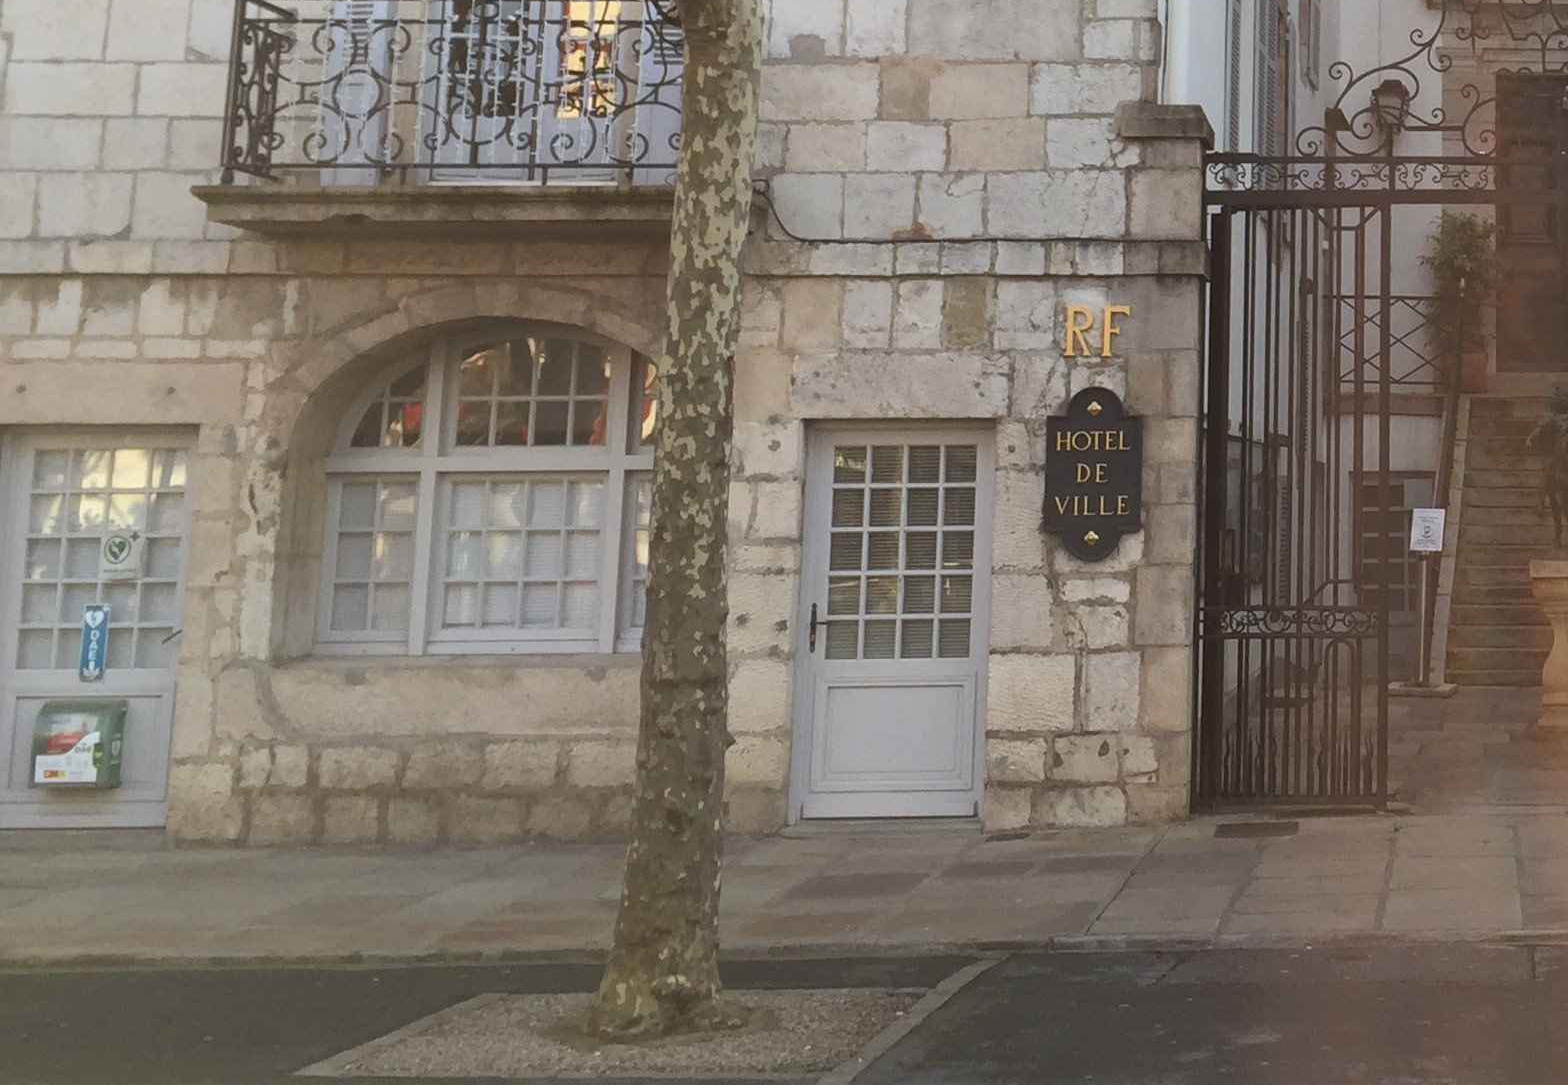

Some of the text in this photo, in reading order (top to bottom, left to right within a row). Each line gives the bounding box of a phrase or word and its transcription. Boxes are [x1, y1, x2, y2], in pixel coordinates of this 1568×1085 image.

[1063, 304, 1131, 357] RF
[1056, 430, 1131, 451] HOTEL
[1076, 463, 1109, 483] DE
[1054, 495, 1130, 516] VILLE
[88, 630, 100, 661] DAE
